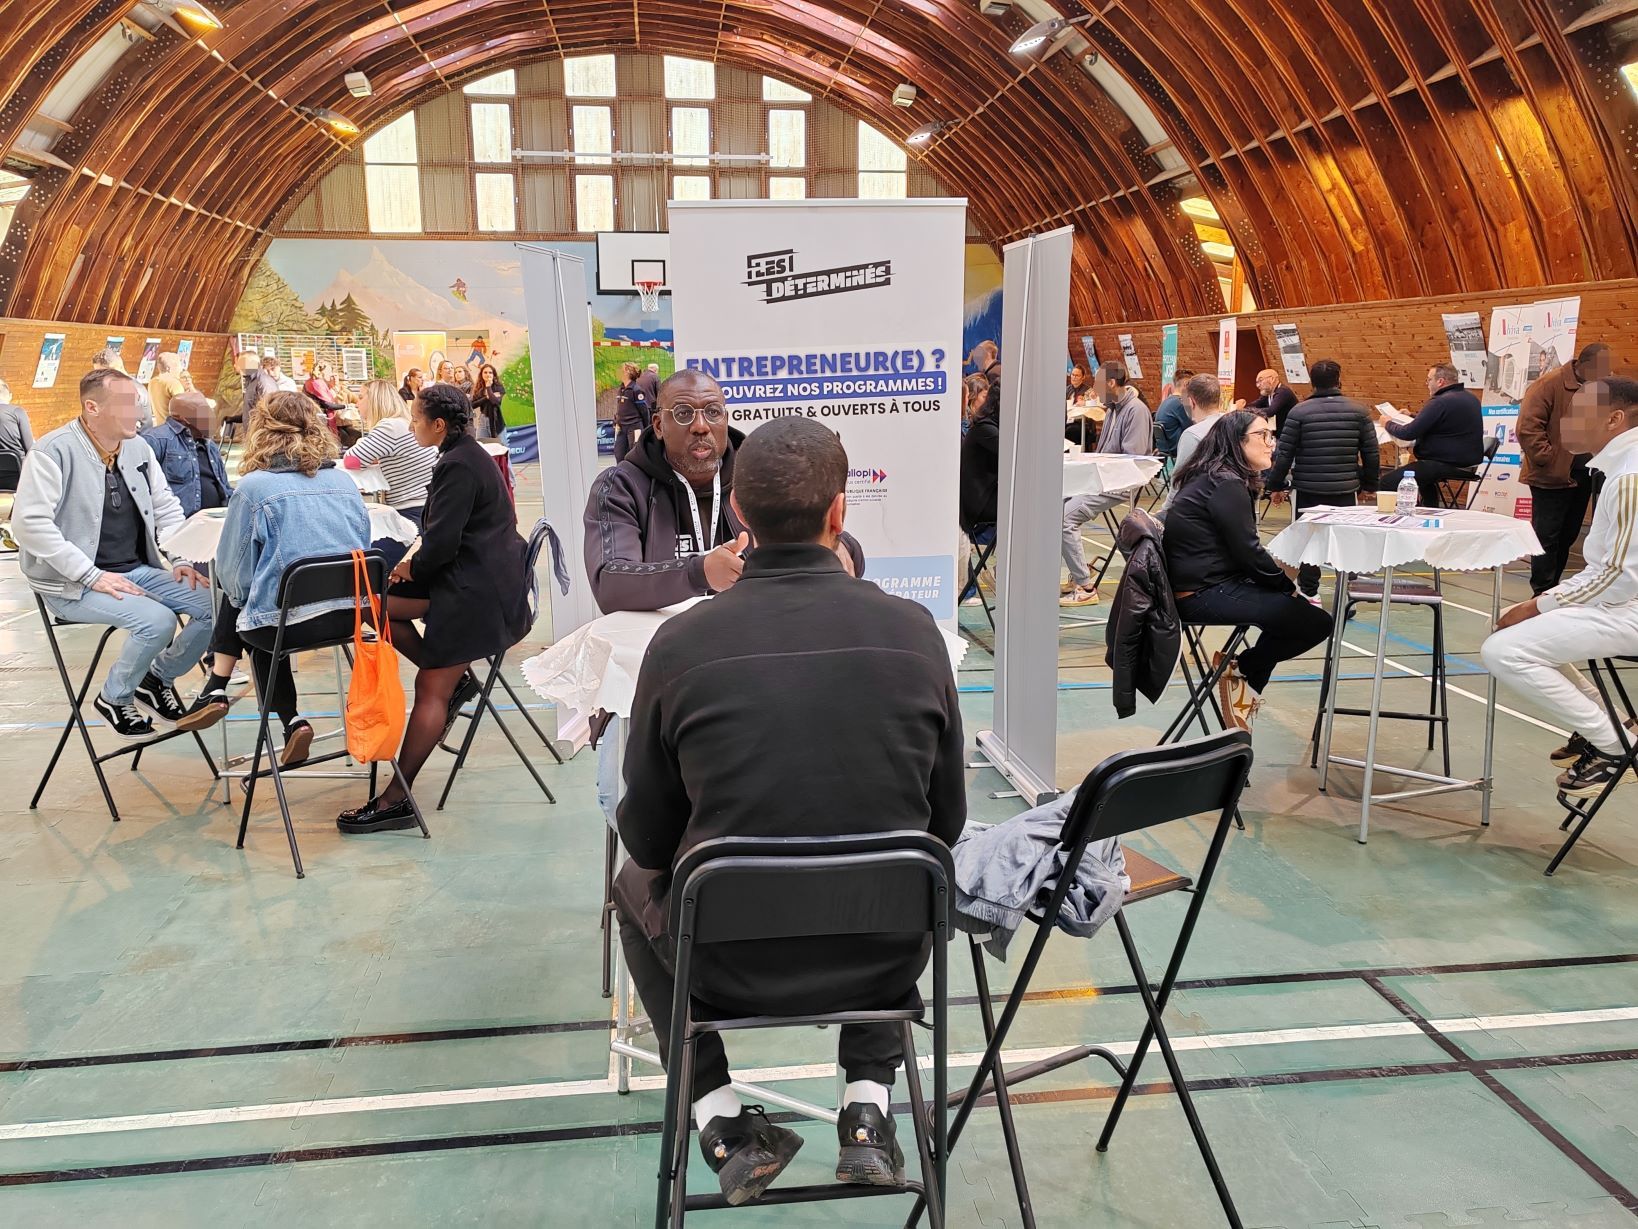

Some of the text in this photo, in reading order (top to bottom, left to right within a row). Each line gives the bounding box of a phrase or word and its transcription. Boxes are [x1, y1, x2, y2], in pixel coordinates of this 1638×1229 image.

[753, 257, 788, 279] LES
[771, 263, 887, 299] DÉTERMINÉS
[686, 348, 945, 378] ENTREPRENEUR(E) ?
[721, 377, 943, 399] OUVREZ NOS PROGRAMMES !
[732, 398, 941, 421] GRATUITS & OUVERTS À TOUS
[874, 576, 942, 589] GRAMME
